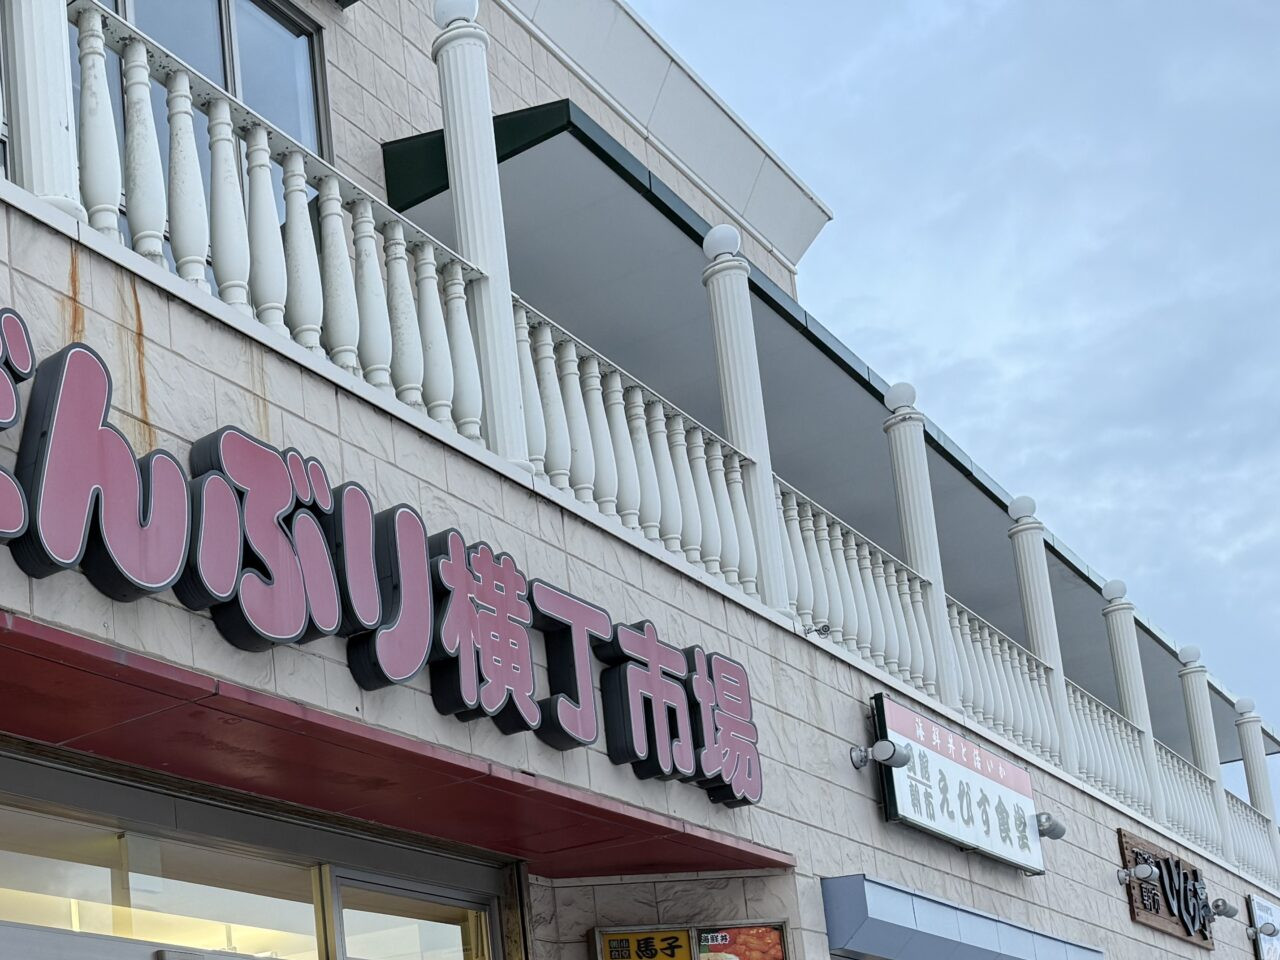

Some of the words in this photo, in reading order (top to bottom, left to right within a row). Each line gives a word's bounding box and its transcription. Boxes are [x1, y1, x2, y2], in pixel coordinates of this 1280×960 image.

[938, 768, 1031, 853] えびす食堂
[635, 936, 683, 960] 馬子
